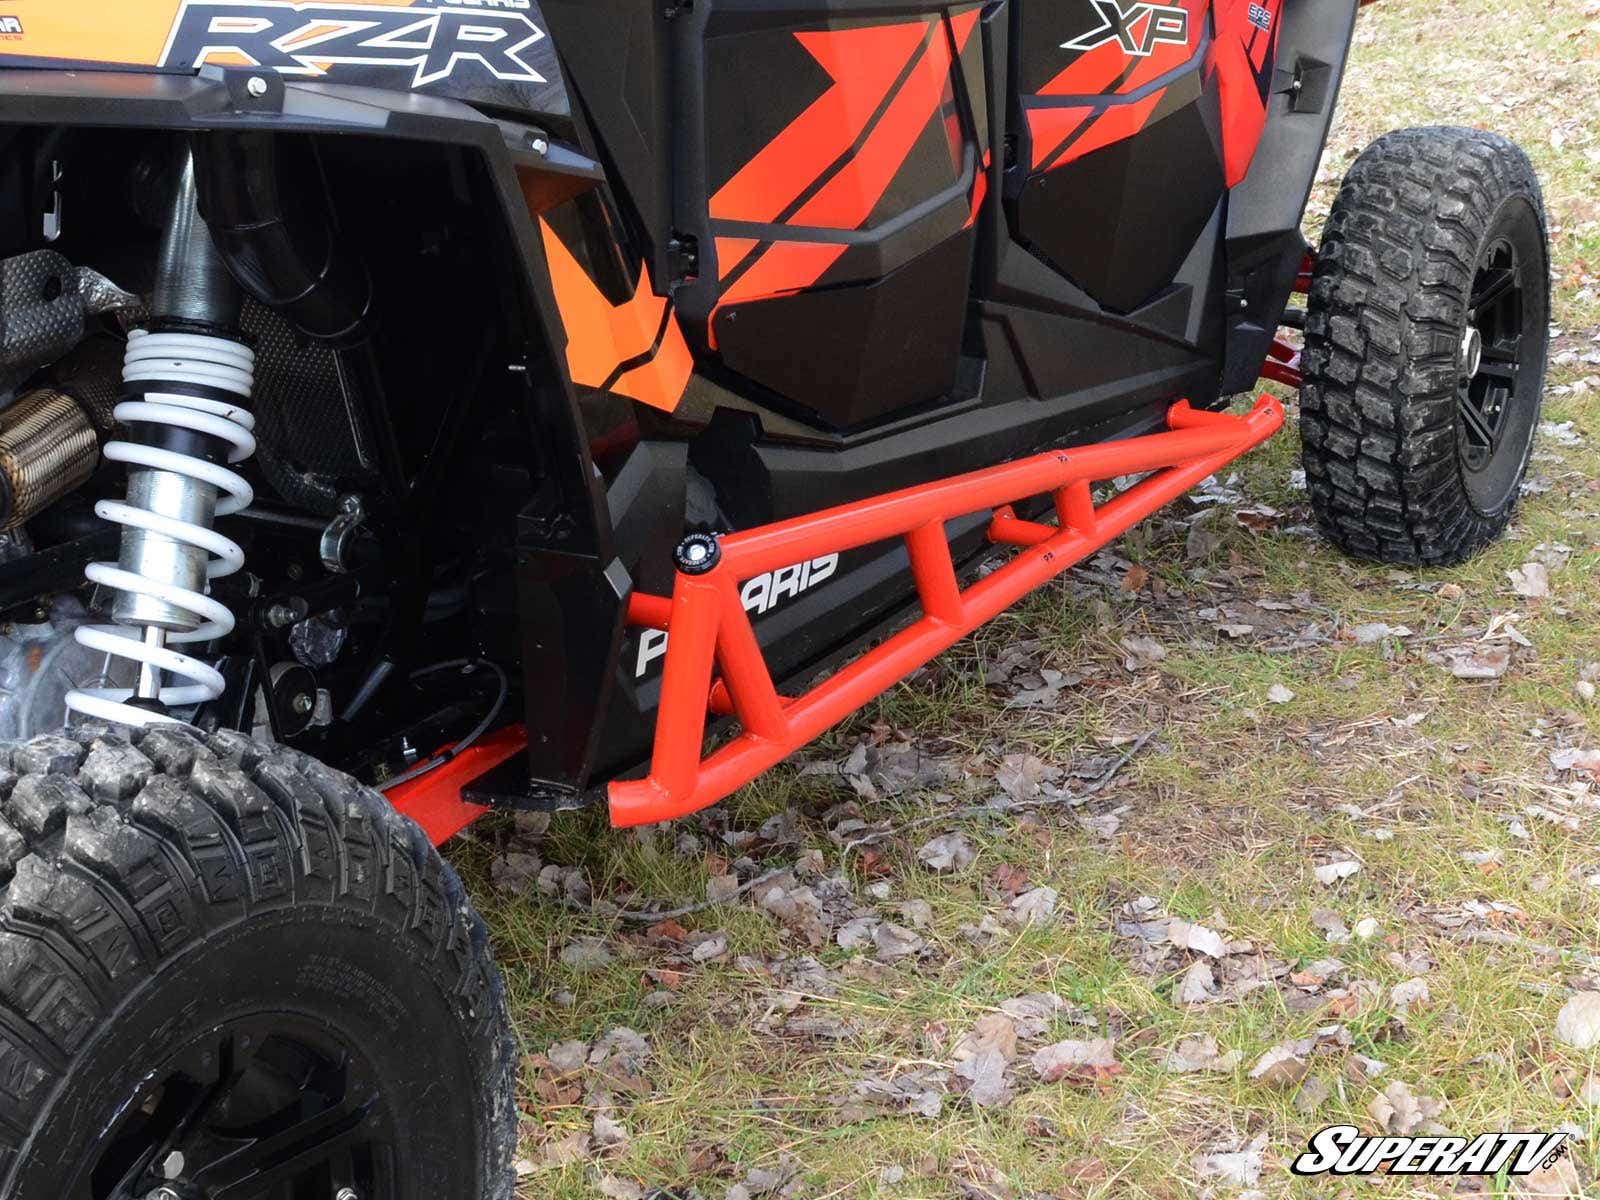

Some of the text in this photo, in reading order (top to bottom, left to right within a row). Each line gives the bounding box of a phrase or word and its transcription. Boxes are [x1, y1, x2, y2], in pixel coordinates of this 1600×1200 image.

[157, 0, 547, 88] RZR
[1059, 0, 1188, 56] XP
[635, 552, 839, 678] PARIS
